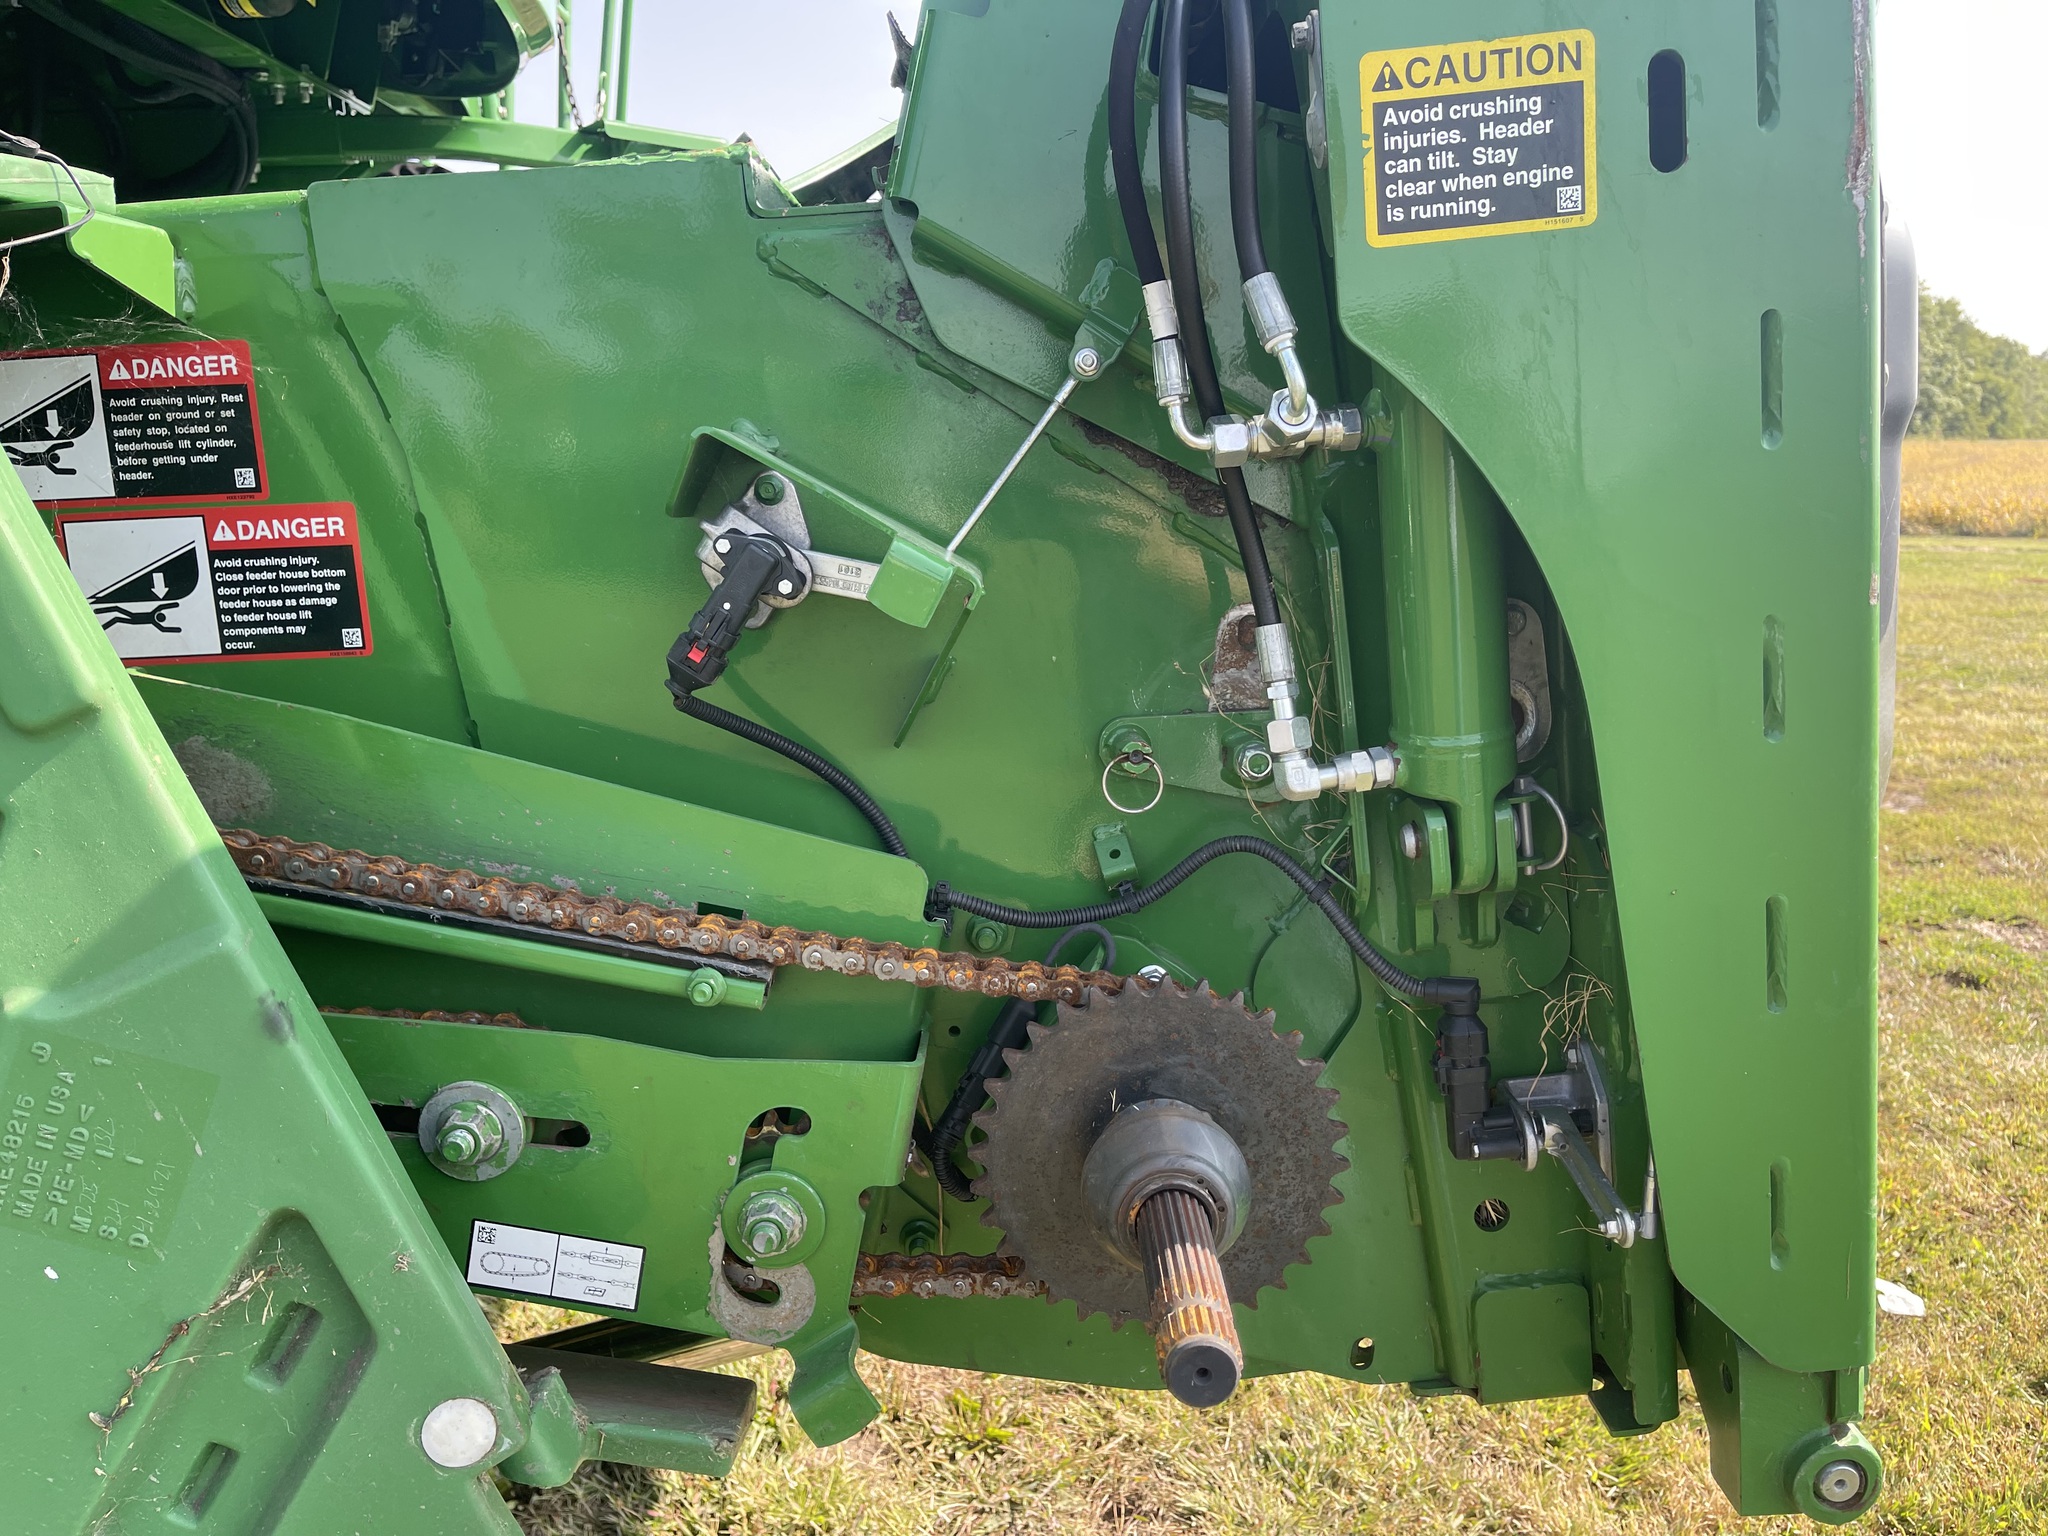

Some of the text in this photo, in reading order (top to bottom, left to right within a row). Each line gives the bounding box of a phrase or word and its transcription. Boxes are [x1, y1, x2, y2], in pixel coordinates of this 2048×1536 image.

[1406, 40, 1582, 88] CAUTION
[1382, 94, 1542, 127] Avoid crushing
[1384, 118, 1554, 153] injuries. Header
[1384, 146, 1518, 175] can tilt. Stay
[1385, 163, 1574, 198] clear when engine
[1386, 197, 1496, 222] is running.
[1545, 217, 1574, 226] H151607
[132, 354, 238, 379] DANGER
[109, 393, 244, 407] Avoid crushing injury. Rest
[111, 412, 143, 422] header
[148, 412, 161, 420] on
[166, 410, 199, 421] ground
[220, 408, 235, 418] set
[113, 424, 227, 437] safety stop, located on
[115, 438, 237, 451] feederhouse lift cylinder,
[117, 453, 218, 466] before getting under
[119, 470, 154, 480] header.
[236, 517, 345, 540] DANGER
[214, 556, 320, 568] Avoid crushing injury.
[215, 568, 346, 582] Close feeder house bottom
[217, 582, 340, 597] door prior to lowering the
[219, 599, 250, 609] feeder
[252, 598, 282, 608] house
[299, 596, 338, 606] damage
[221, 610, 312, 623] to feeder house lift
[223, 624, 307, 637] components may
[225, 640, 256, 649] occur.
[12, 1070, 76, 1218] MADE IN USA
